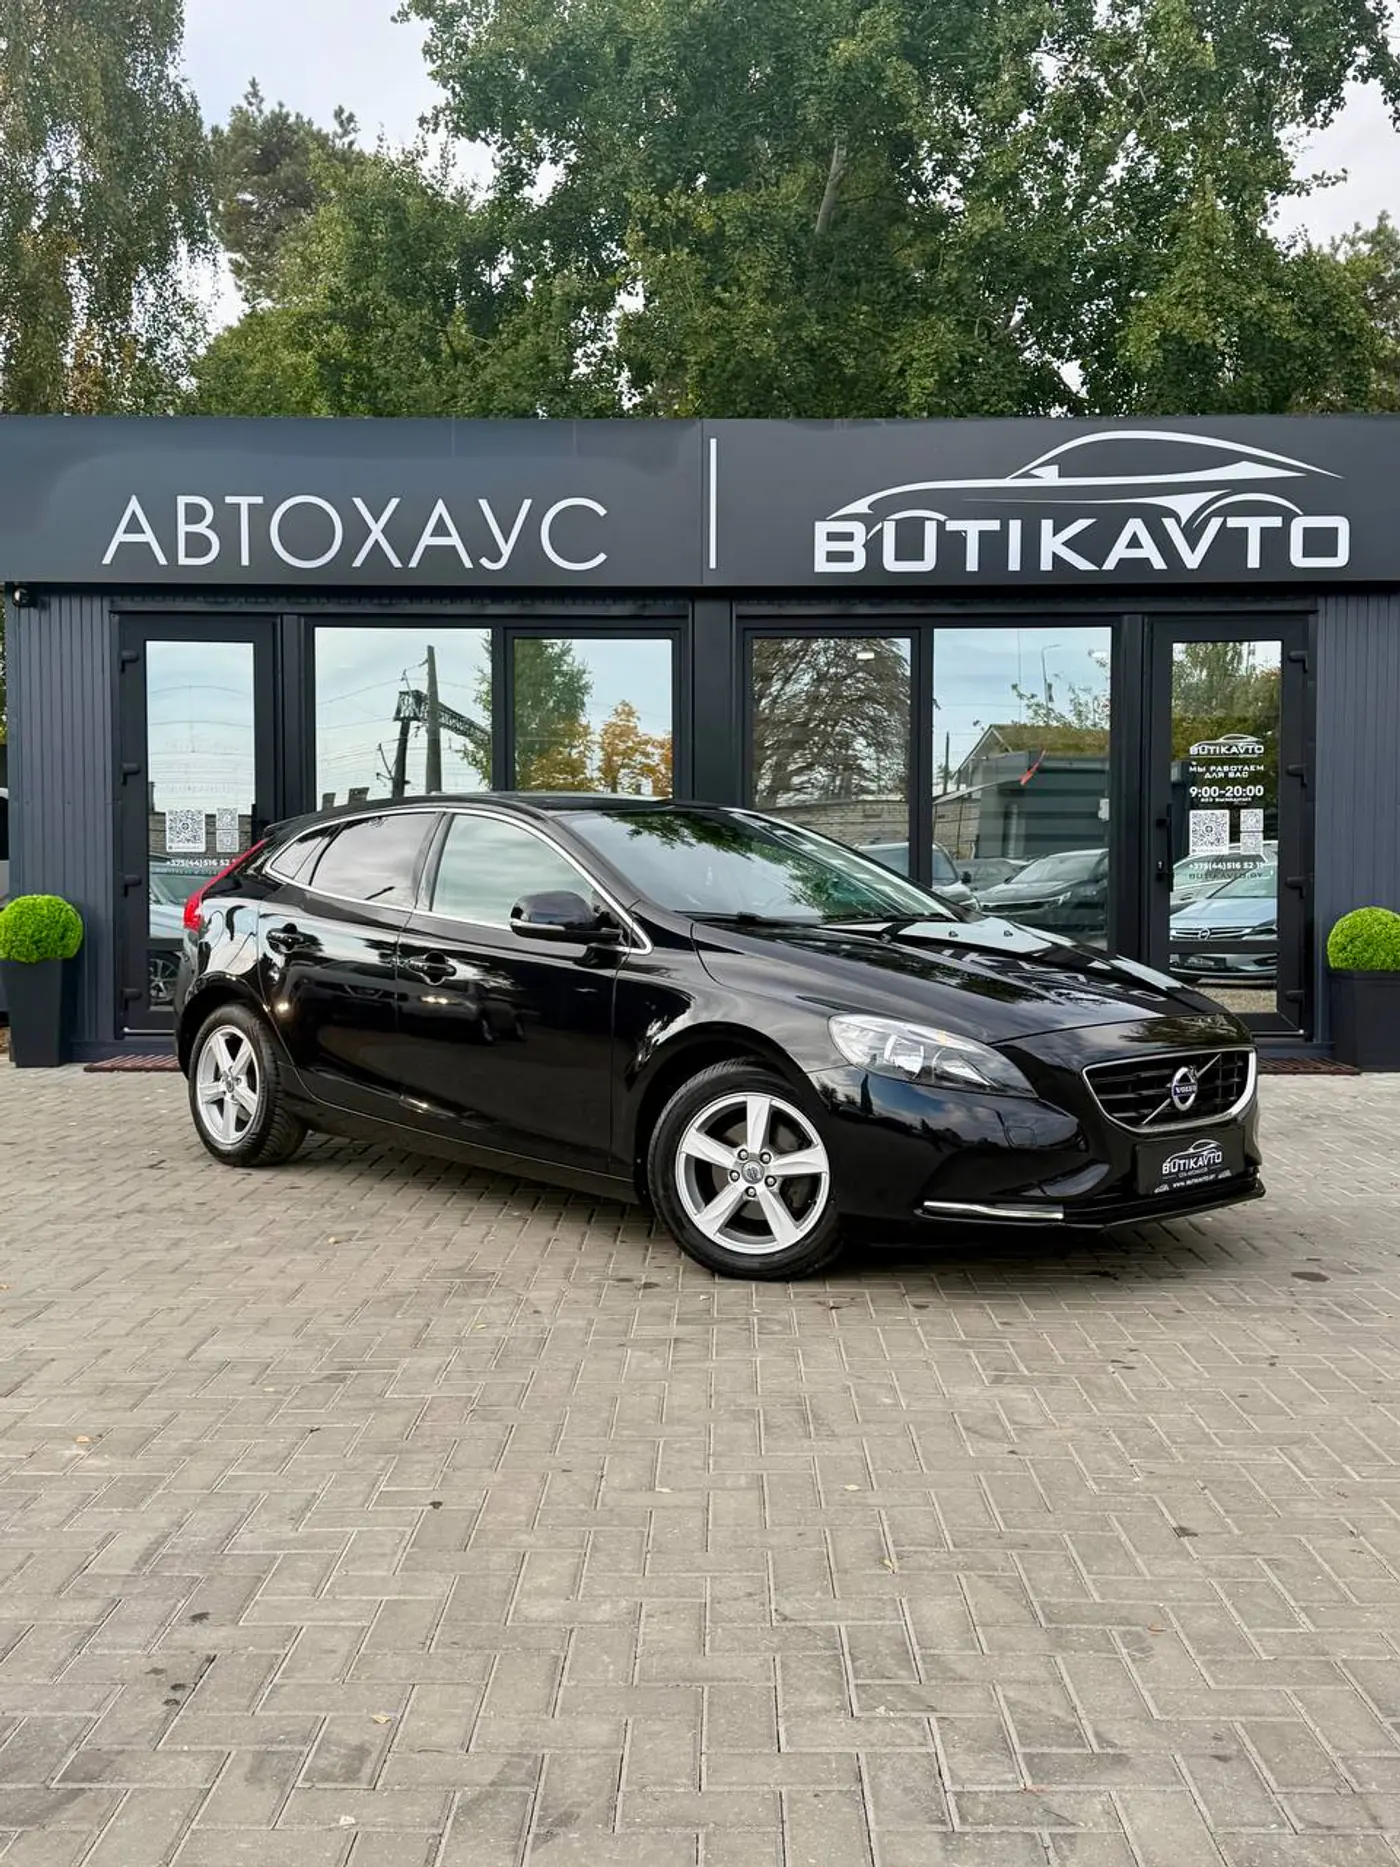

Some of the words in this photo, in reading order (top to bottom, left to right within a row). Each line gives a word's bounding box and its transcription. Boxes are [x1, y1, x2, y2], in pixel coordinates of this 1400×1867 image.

[101, 494, 608, 570] АВТОХАУС
[814, 514, 1350, 573] BUTIKAVTO
[1188, 745, 1264, 755] BUTIKAVTO
[1189, 785, 1264, 797] 9:00-20:00
[1162, 1151, 1222, 1174] BUTIKAVTO
